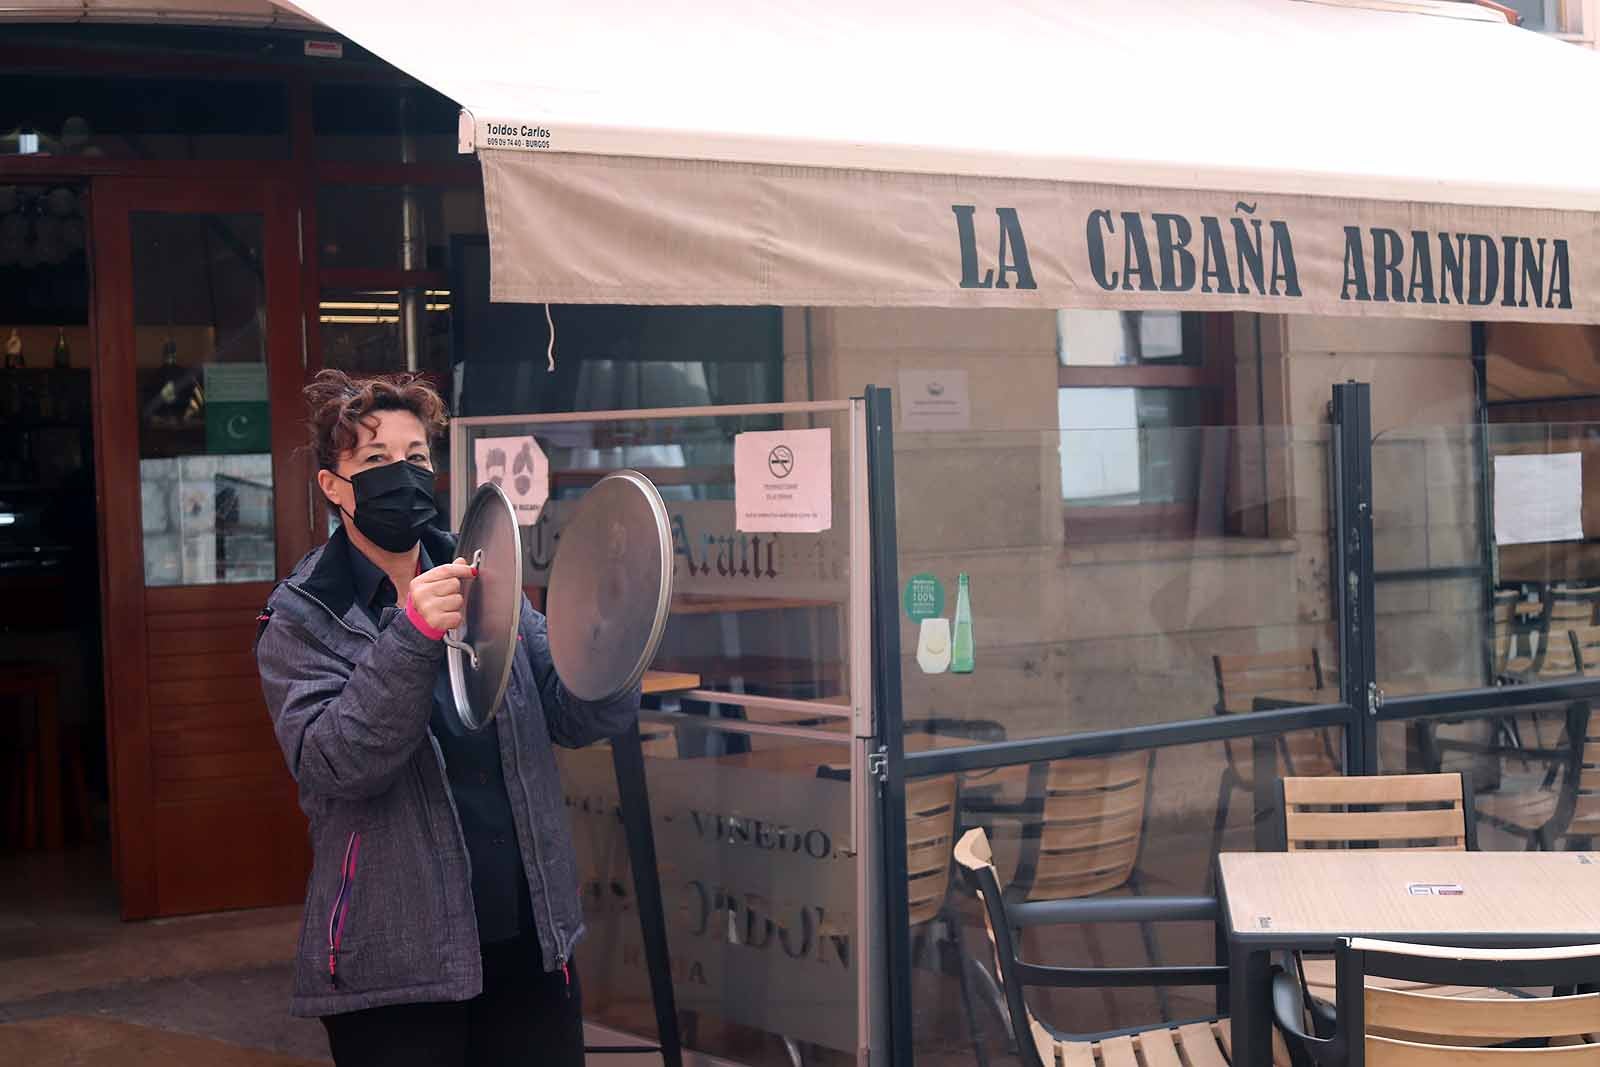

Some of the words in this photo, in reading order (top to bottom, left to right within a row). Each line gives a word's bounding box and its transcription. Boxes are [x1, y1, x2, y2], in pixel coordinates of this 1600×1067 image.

[487, 123, 518, 136] Toldos
[520, 125, 551, 138] Carlos
[525, 139, 550, 149] BURGOS
[951, 205, 1038, 290] LA
[1086, 201, 1303, 297] CABAÑA
[1340, 226, 1573, 309] ARANDINA
